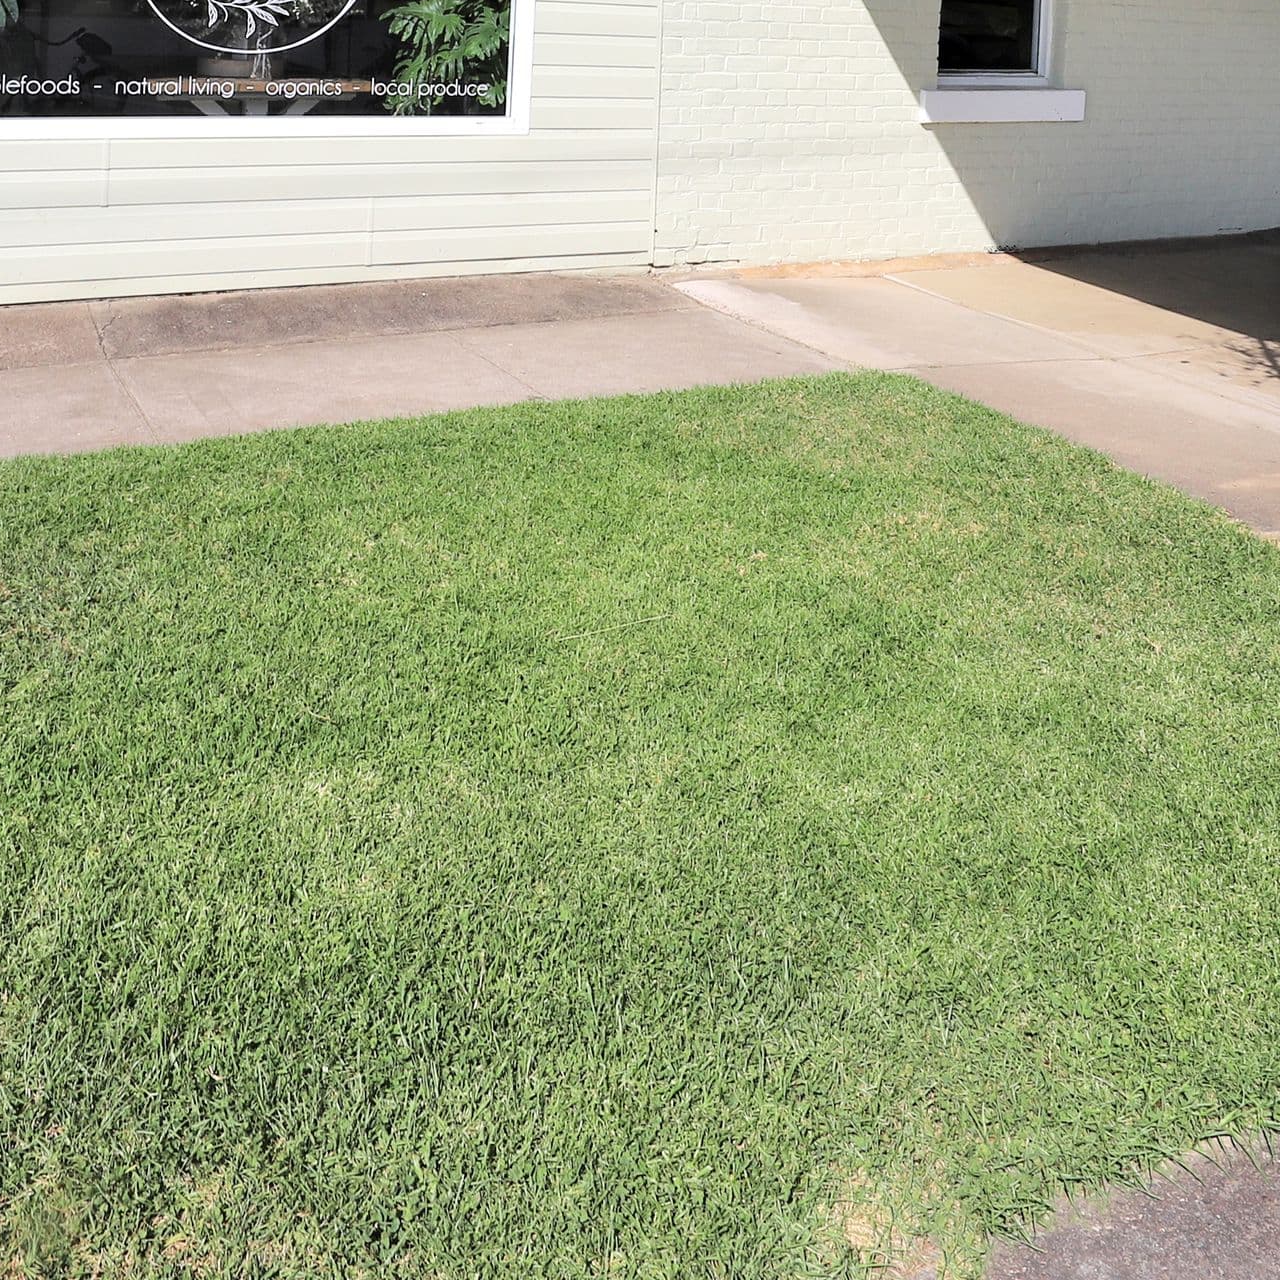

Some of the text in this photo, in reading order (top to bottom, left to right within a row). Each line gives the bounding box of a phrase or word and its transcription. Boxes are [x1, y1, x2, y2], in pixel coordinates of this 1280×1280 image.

[114, 76, 182, 96] natural
[187, 74, 235, 99] living
[265, 77, 342, 99] organics
[370, 77, 414, 97] local
[417, 77, 489, 98] produce
